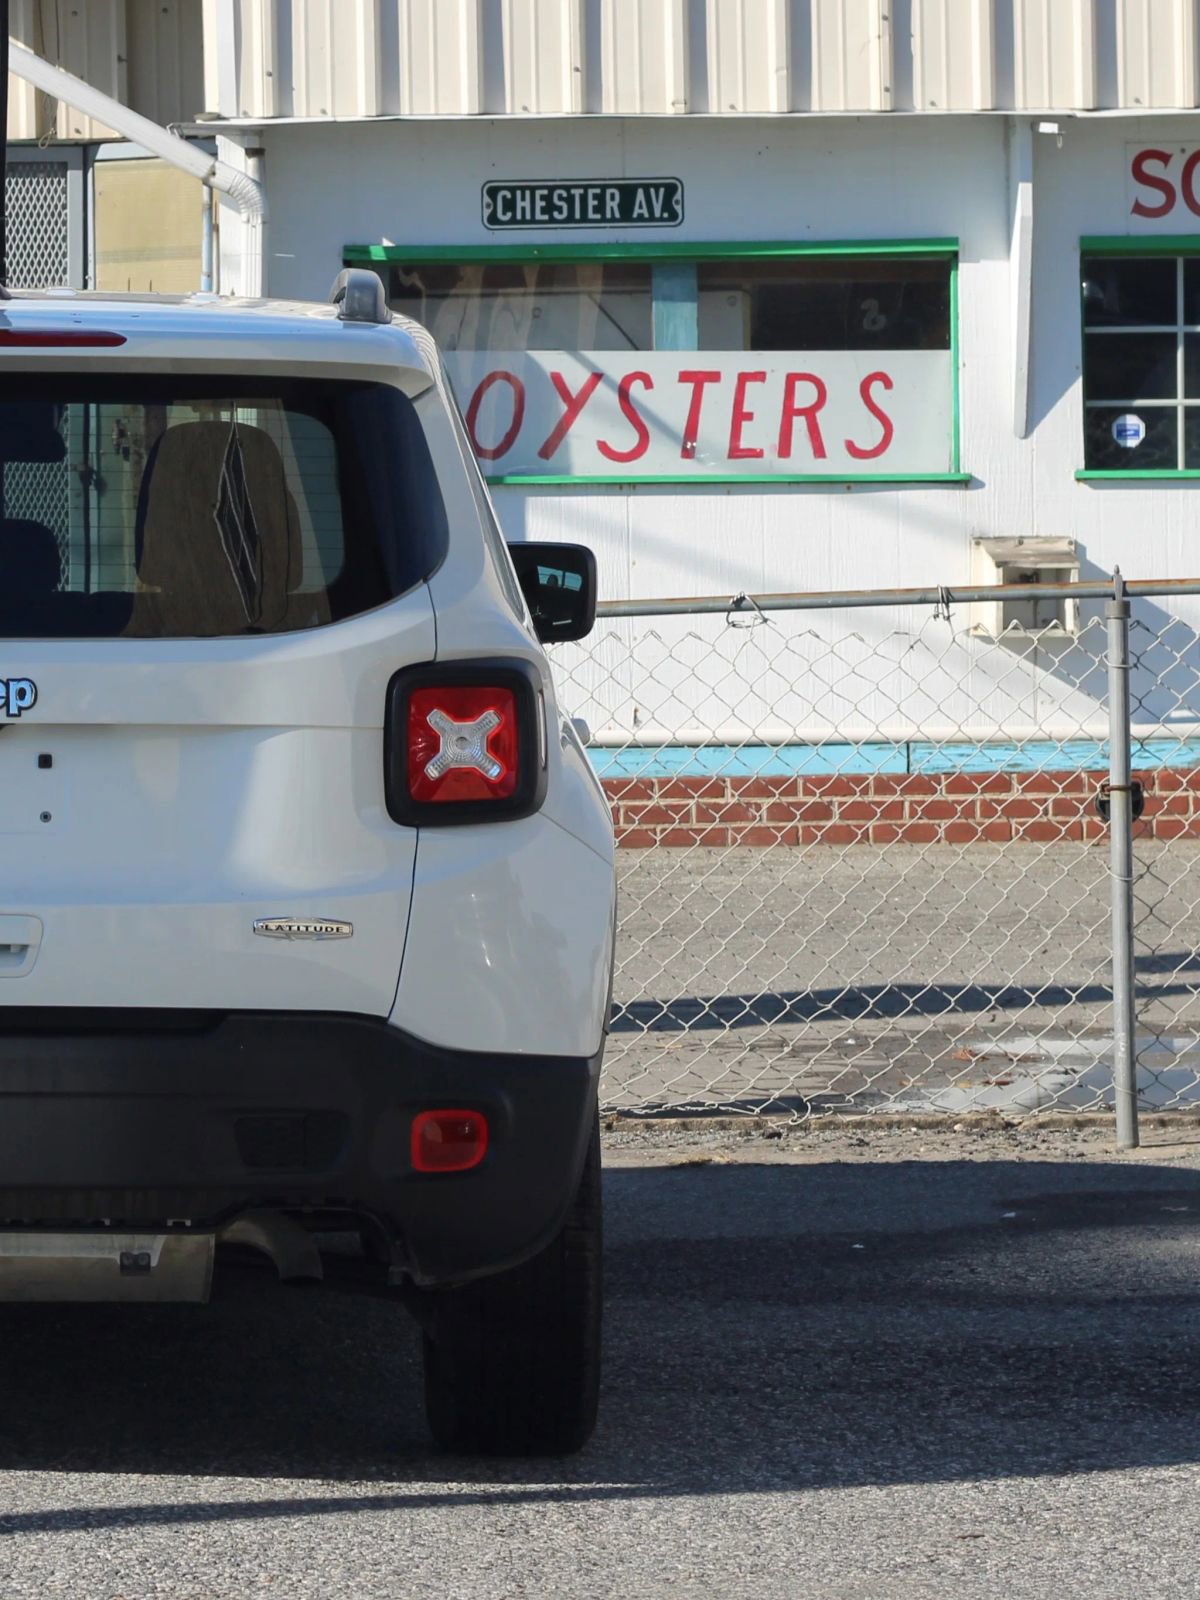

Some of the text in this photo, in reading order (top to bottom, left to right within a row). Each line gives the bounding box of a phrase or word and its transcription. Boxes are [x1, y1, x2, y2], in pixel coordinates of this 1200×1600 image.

[496, 187, 668, 221] CHESTER AV.
[468, 370, 895, 463] OYSTERS
[264, 924, 344, 934] LATITUDE
